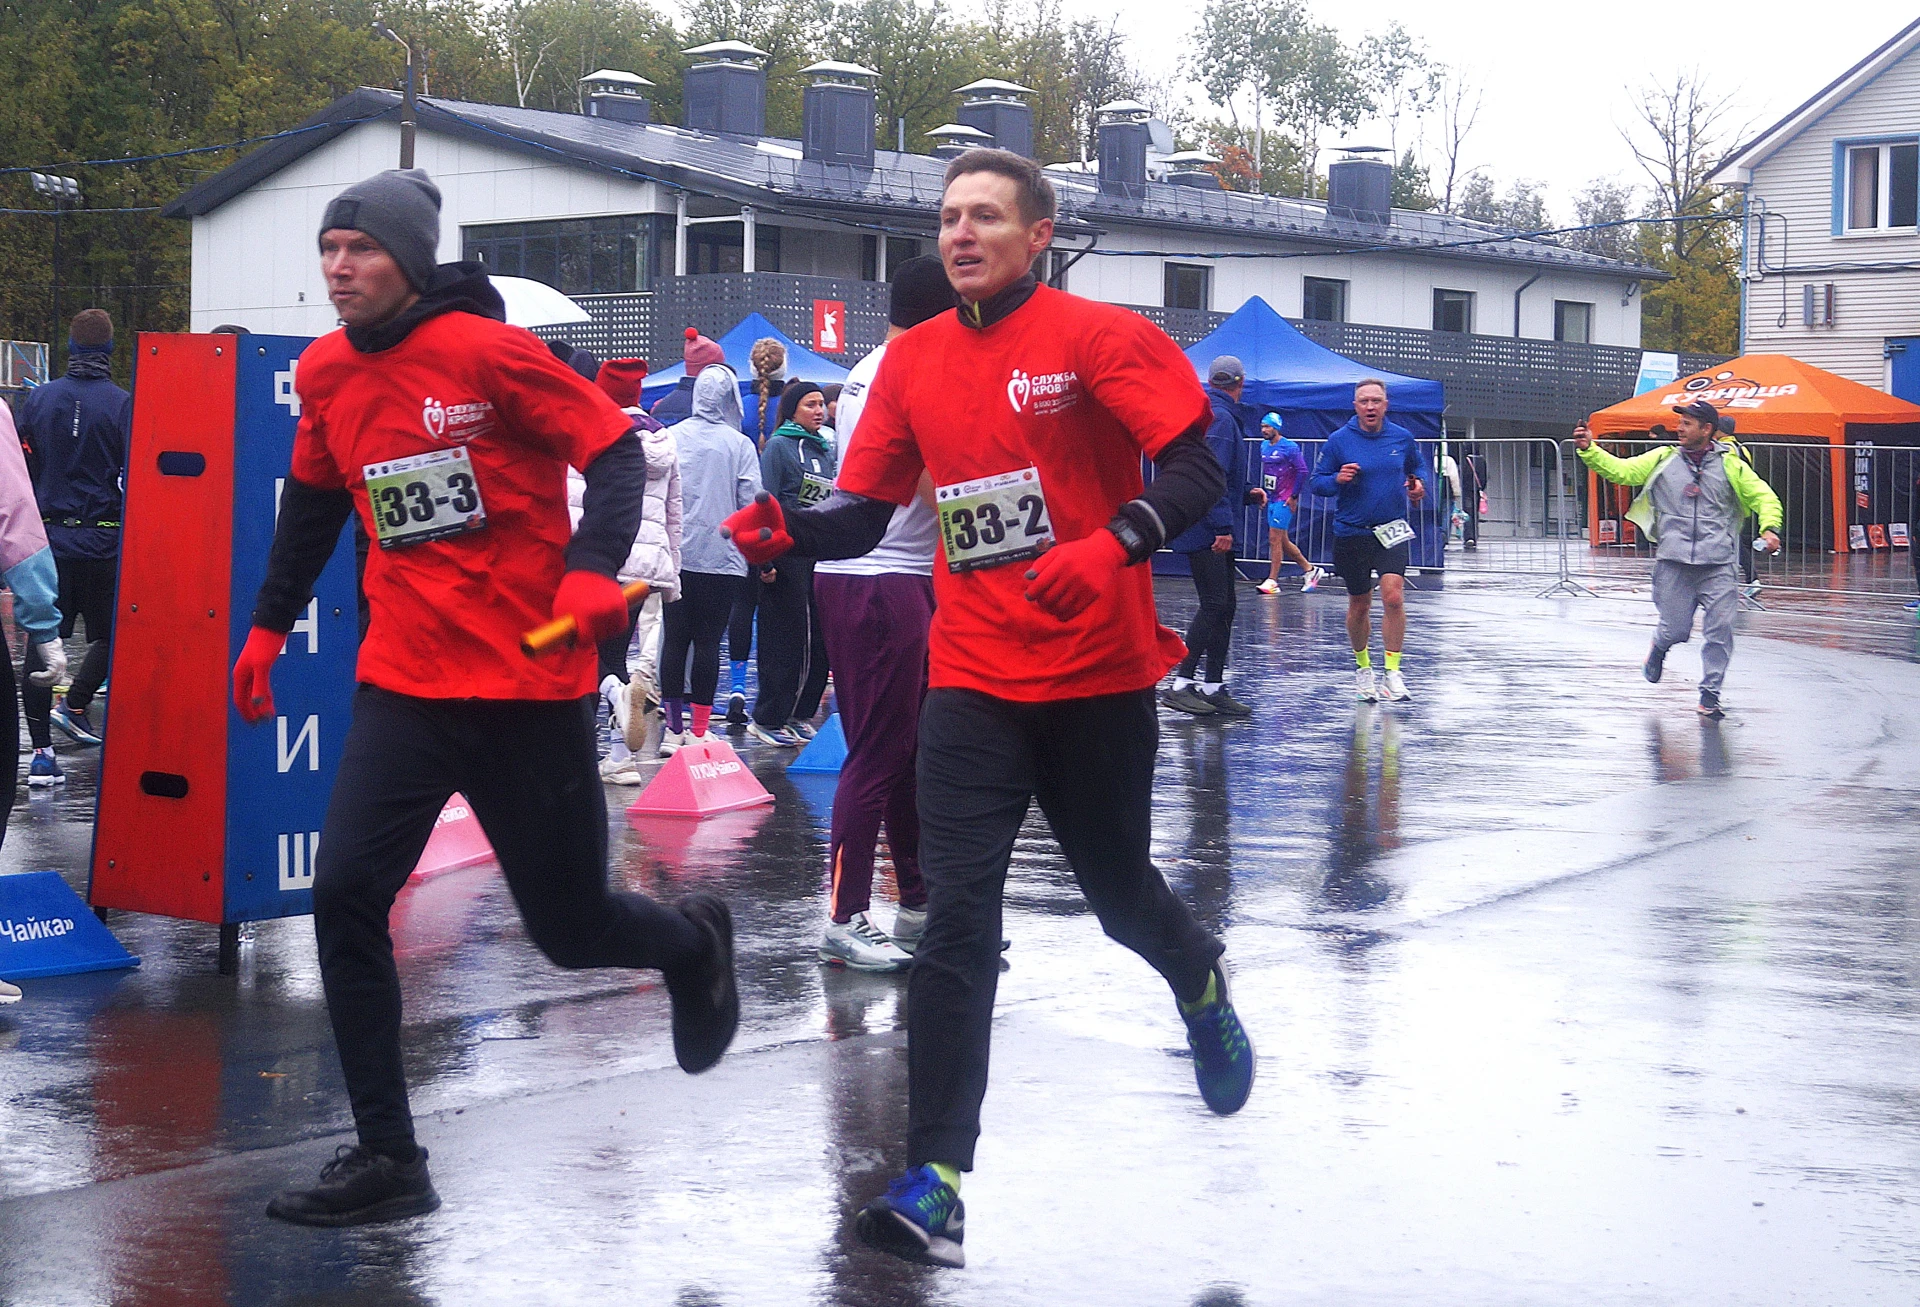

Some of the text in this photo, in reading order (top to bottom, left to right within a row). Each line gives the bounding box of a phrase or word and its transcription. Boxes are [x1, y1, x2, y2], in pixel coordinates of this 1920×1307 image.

[1032, 371, 1077, 386] СЛУЖБА
[1032, 382, 1069, 396] КРОВИ
[1660, 383, 1799, 406] КУЗНИЦА
[381, 472, 478, 527] 33-3
[952, 494, 1049, 550] 33-2
[1381, 522, 1410, 541] 12-2
[0, 916, 74, 943] Чайка»
